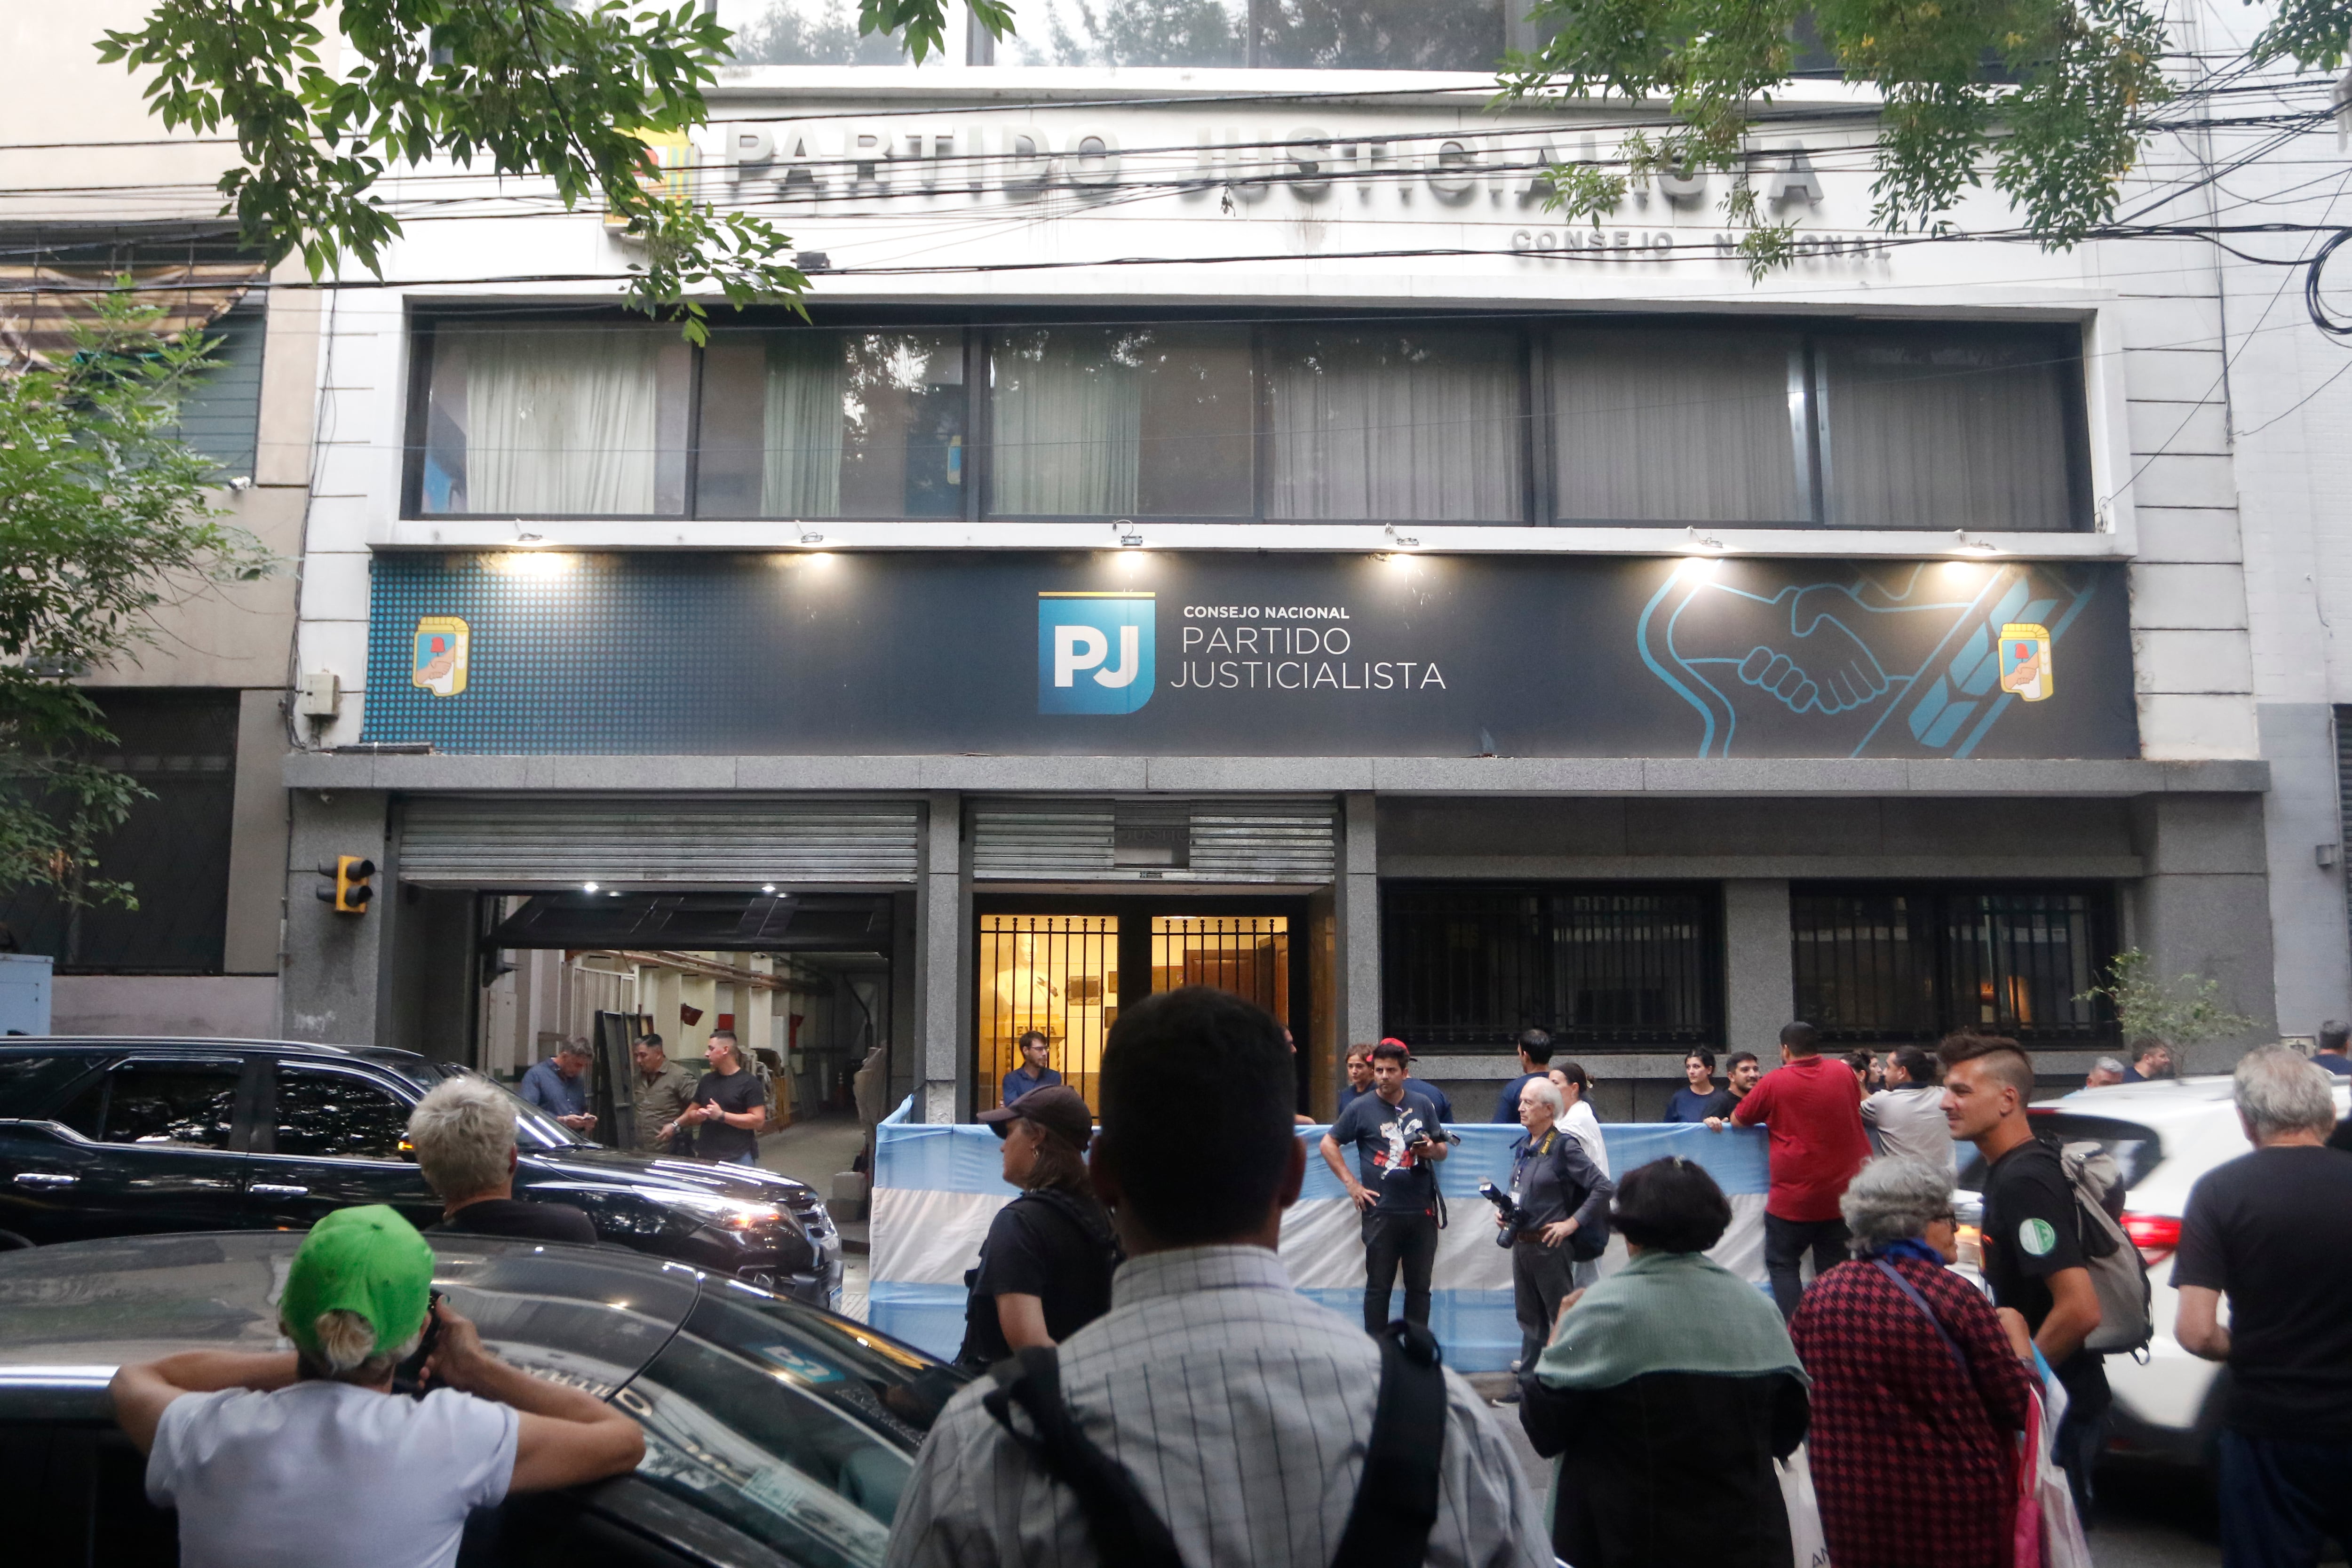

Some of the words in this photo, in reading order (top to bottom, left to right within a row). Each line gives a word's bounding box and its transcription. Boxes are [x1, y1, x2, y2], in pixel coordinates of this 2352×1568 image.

[725, 122, 1120, 187] PARTIDO
[1511, 229, 1674, 257] CONSEJO
[1714, 233, 1891, 260] NIONAL
[1184, 605, 1260, 618] CONSEJO
[1265, 606, 1350, 619] NACIONAL
[1183, 627, 1351, 655] PARTIDO
[1054, 625, 1139, 688] PJ
[1170, 661, 1446, 690] JUSTICIALISTA
